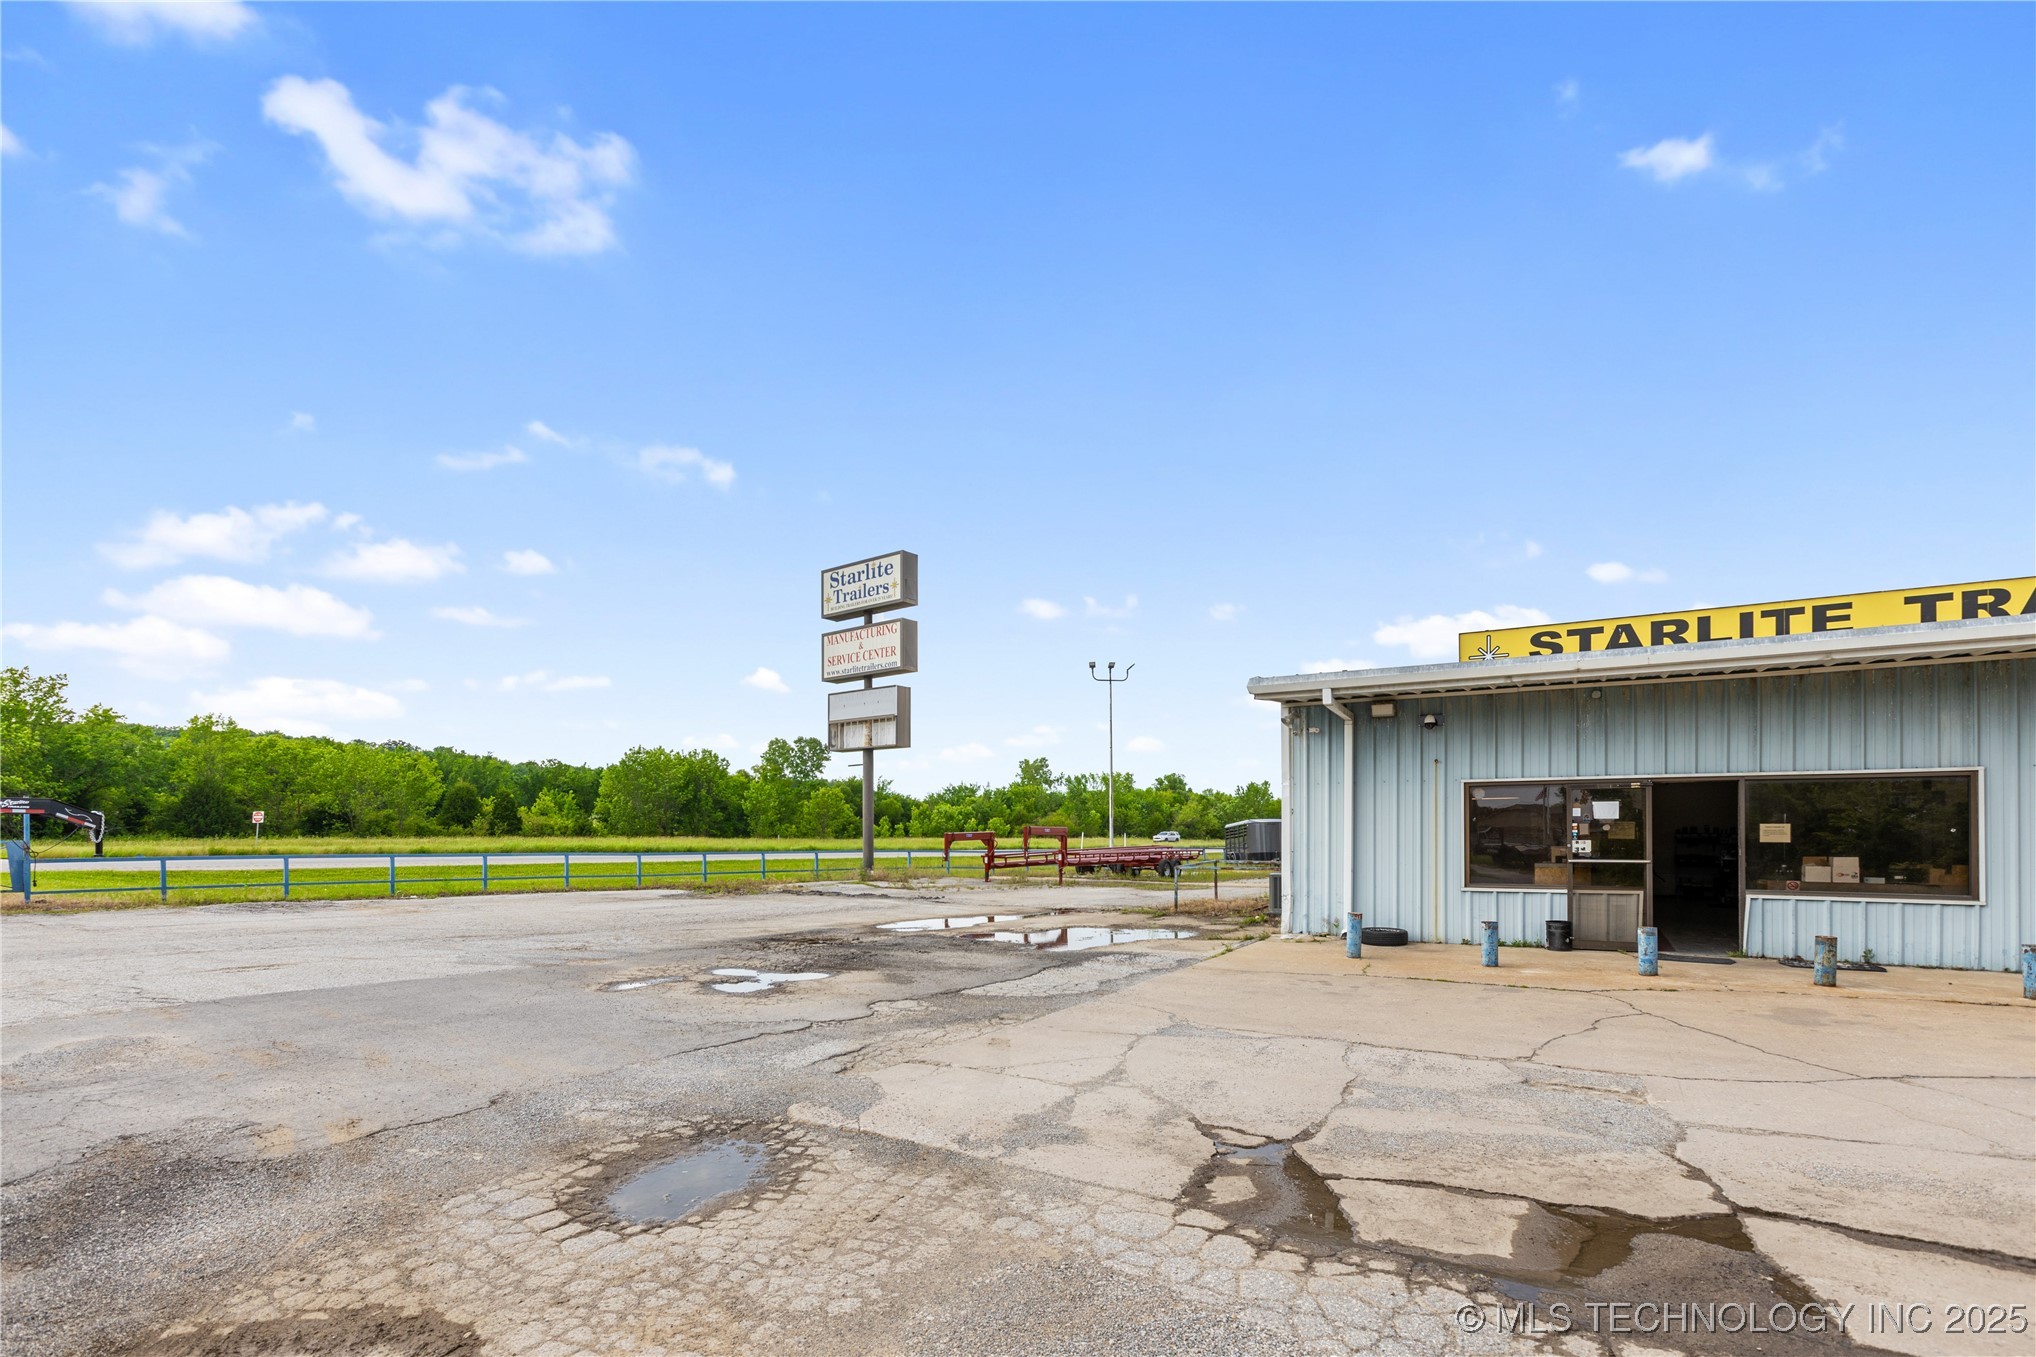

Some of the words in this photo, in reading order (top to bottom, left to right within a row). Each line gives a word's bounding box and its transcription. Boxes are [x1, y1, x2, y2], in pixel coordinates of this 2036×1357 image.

[830, 561, 894, 589] Starlite
[833, 582, 889, 604] Trailers
[1529, 601, 1853, 656] STARLITE
[1904, 586, 2036, 623] TR
[827, 623, 897, 646] MANUFACTURING
[858, 641, 864, 650] &
[827, 651, 861, 667] SERVICE
[862, 645, 896, 661] CENTER
[826, 661, 898, 676] www.starlitetrailers.com
